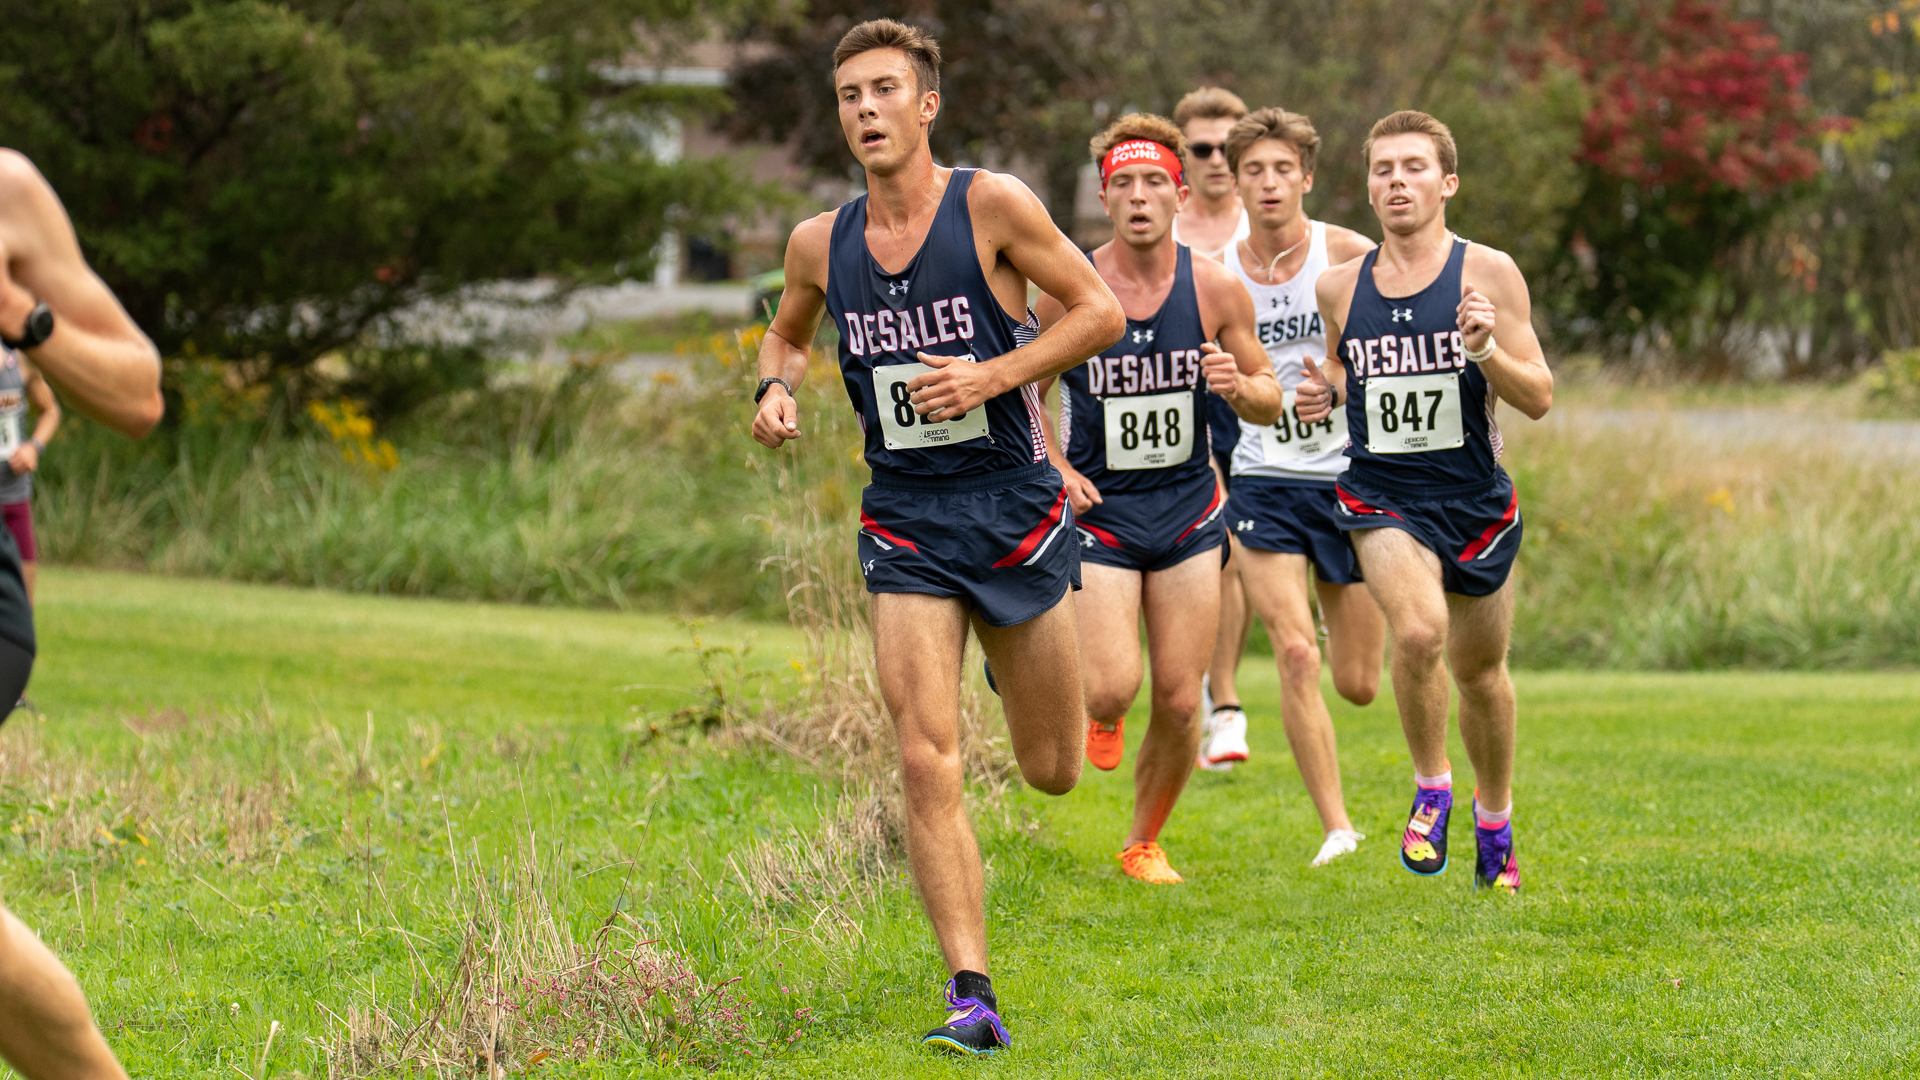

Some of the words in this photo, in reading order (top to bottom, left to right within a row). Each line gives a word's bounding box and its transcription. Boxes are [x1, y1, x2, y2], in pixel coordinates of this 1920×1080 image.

[1111, 149, 1161, 166] POUND
[1113, 141, 1156, 155] DAWG
[844, 296, 975, 356] DESALES
[1258, 312, 1327, 344] ESSIA
[1086, 349, 1200, 394] DESALES
[1345, 330, 1467, 377] DESALES
[1120, 407, 1181, 450] 848
[1379, 389, 1444, 433] 847
